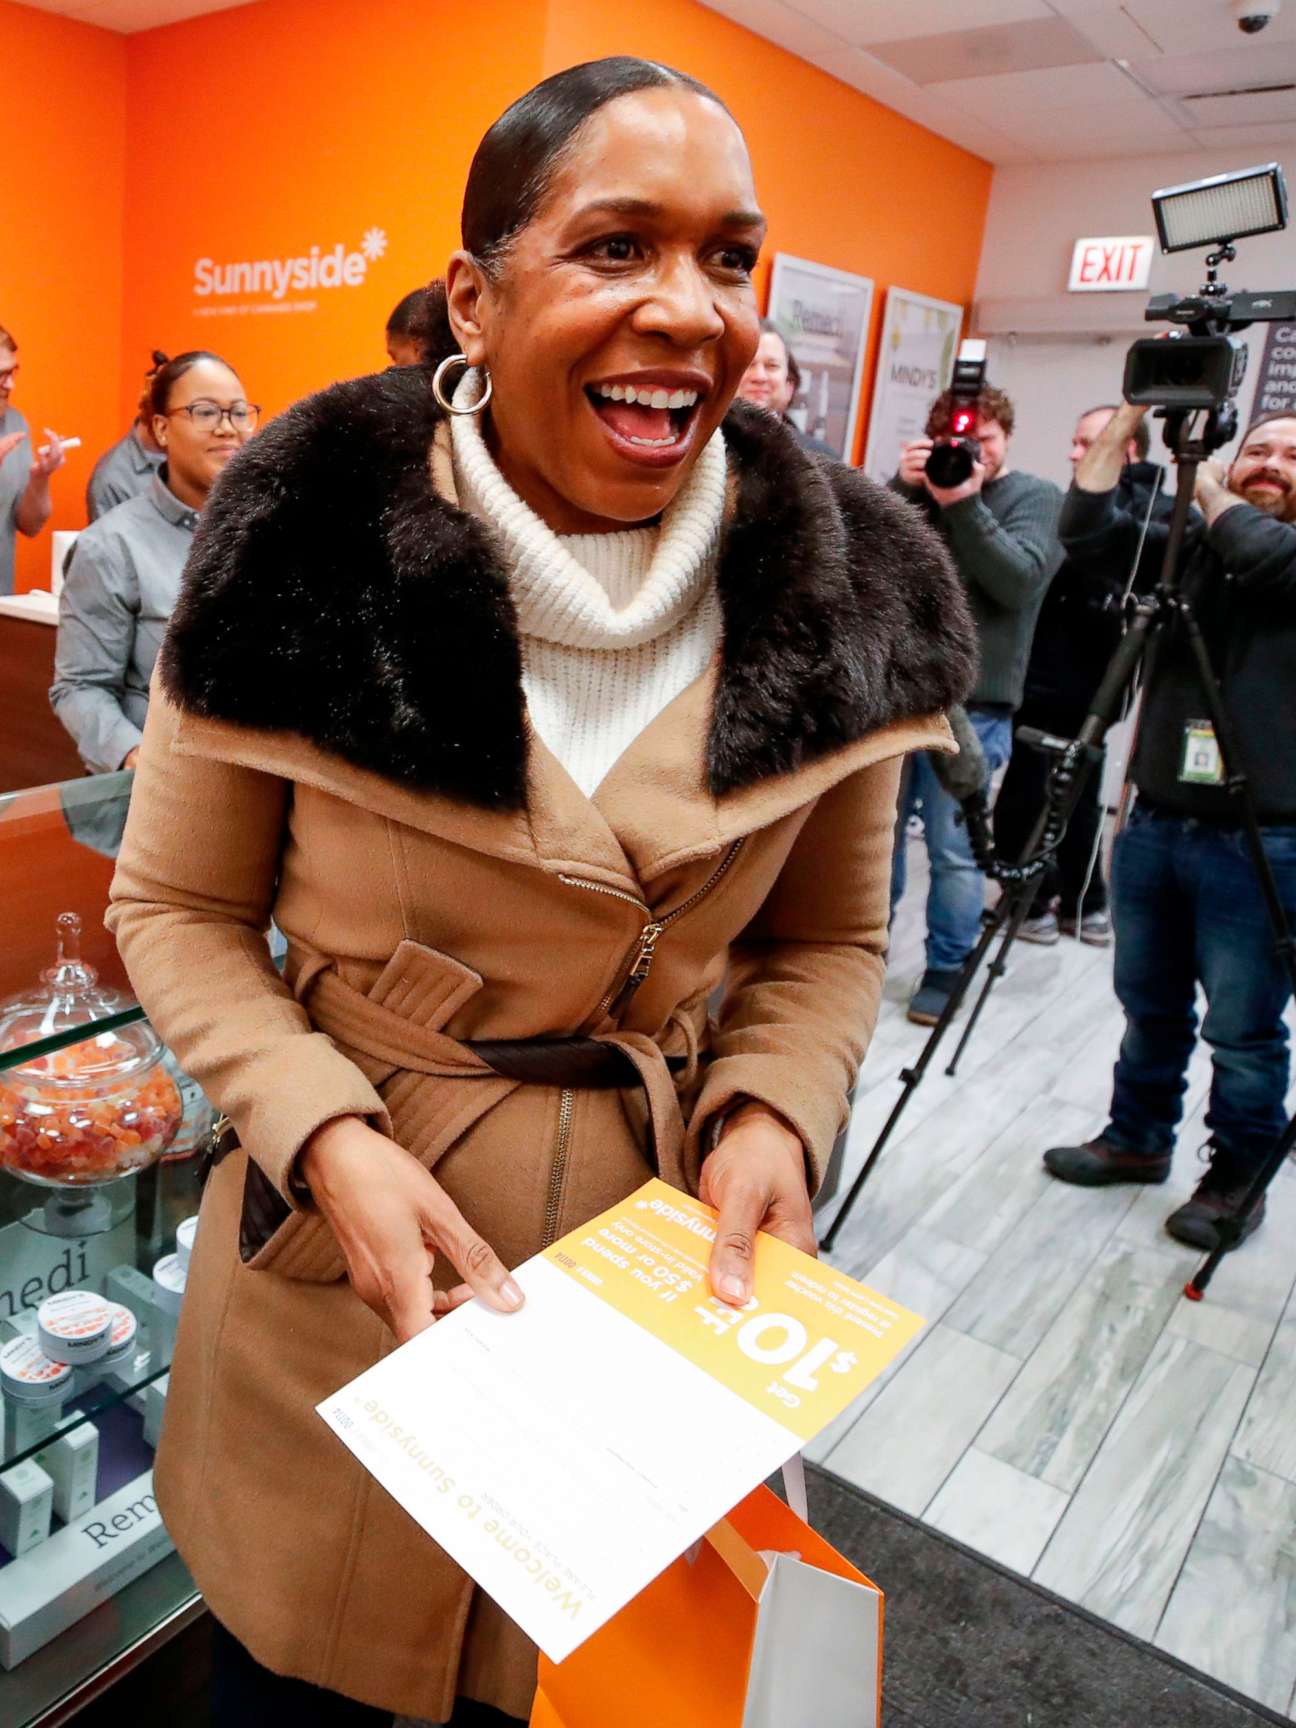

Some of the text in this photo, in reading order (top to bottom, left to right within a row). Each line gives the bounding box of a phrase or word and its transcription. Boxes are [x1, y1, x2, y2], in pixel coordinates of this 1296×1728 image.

[193, 243, 366, 299] Sunnyside
[1079, 244, 1143, 283] EXIT
[891, 365, 937, 389] MINDY'S
[1262, 394, 1290, 409] for
[580, 1235, 630, 1270] spend
[597, 1227, 636, 1255] more
[635, 1252, 655, 1267] or
[629, 1266, 663, 1291] you
[652, 1263, 692, 1294] $50
[659, 1282, 678, 1303] If
[736, 1312, 857, 1392] $10
[766, 1382, 801, 1408] Get
[364, 1399, 583, 1620] Welcome to Sunnyside
